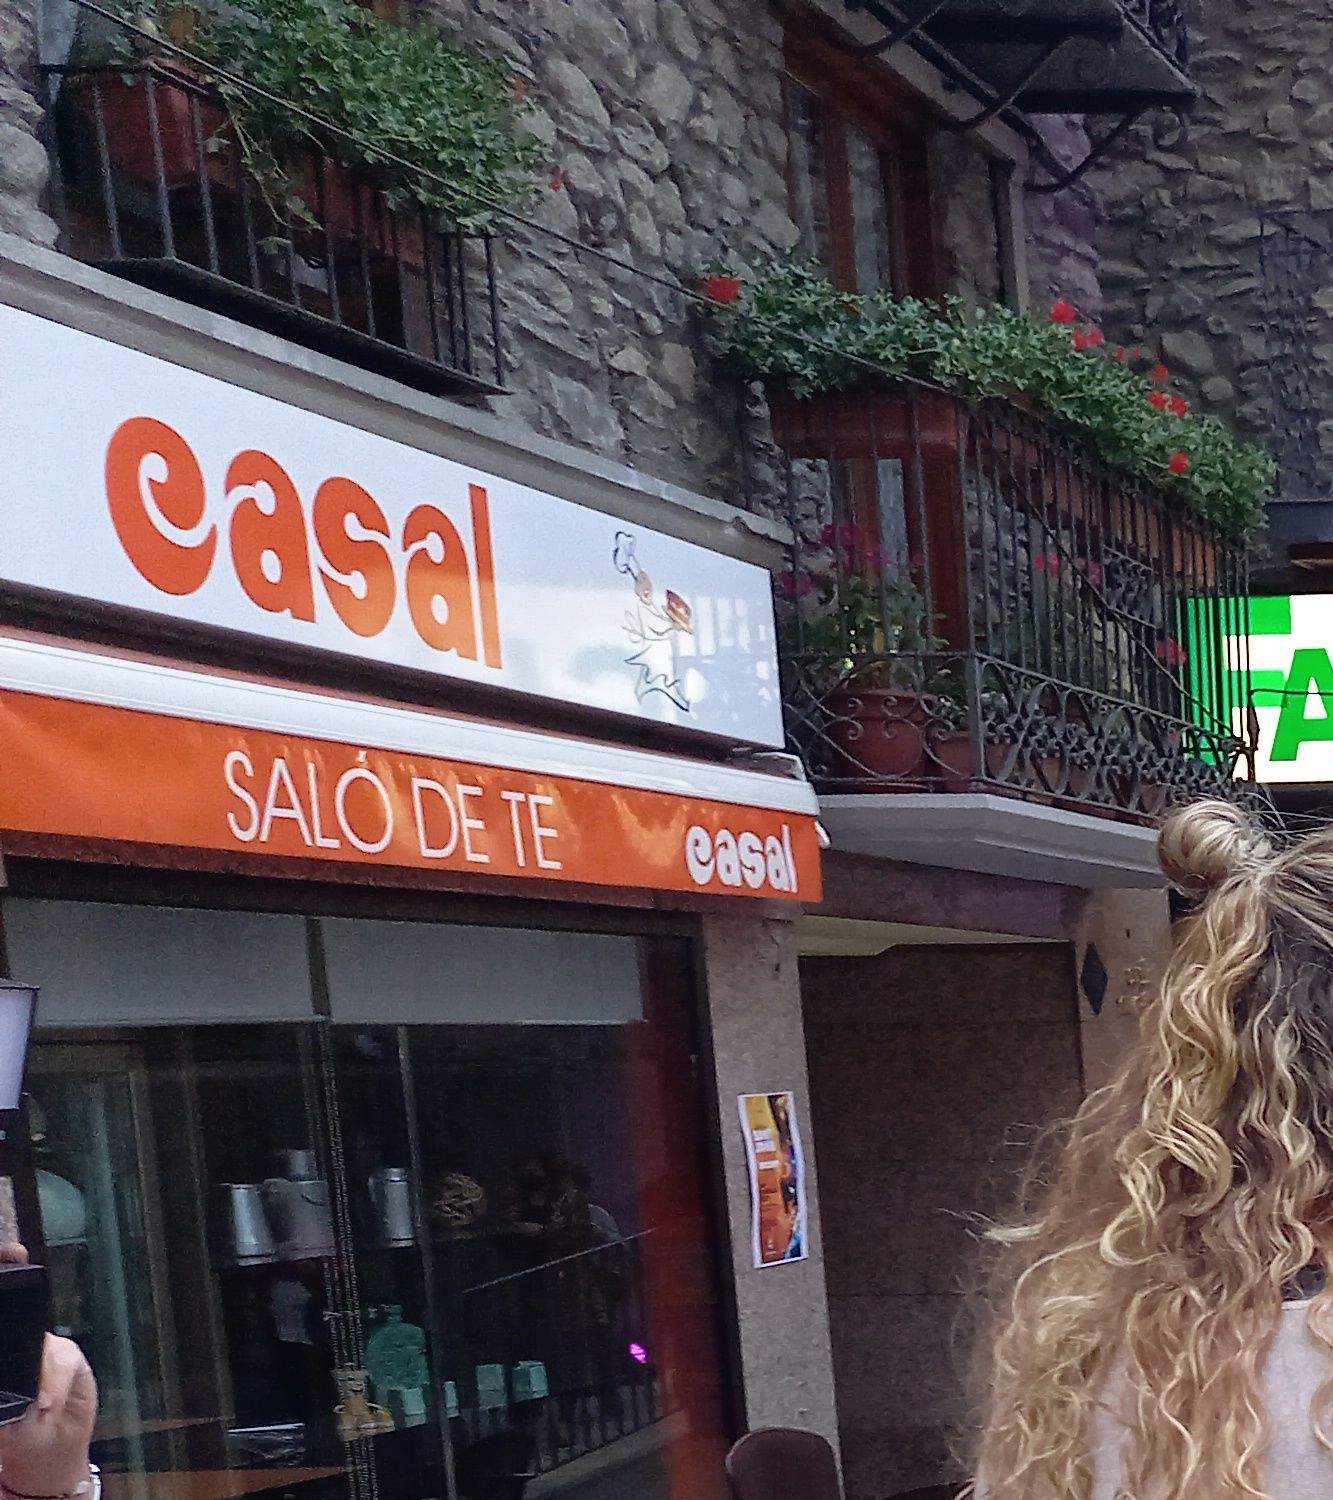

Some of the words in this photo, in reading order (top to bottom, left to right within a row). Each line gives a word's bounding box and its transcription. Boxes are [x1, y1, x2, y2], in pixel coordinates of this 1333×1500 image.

[223, 749, 394, 855] SALÓ
[412, 777, 491, 865] DE
[501, 789, 563, 871] TE
